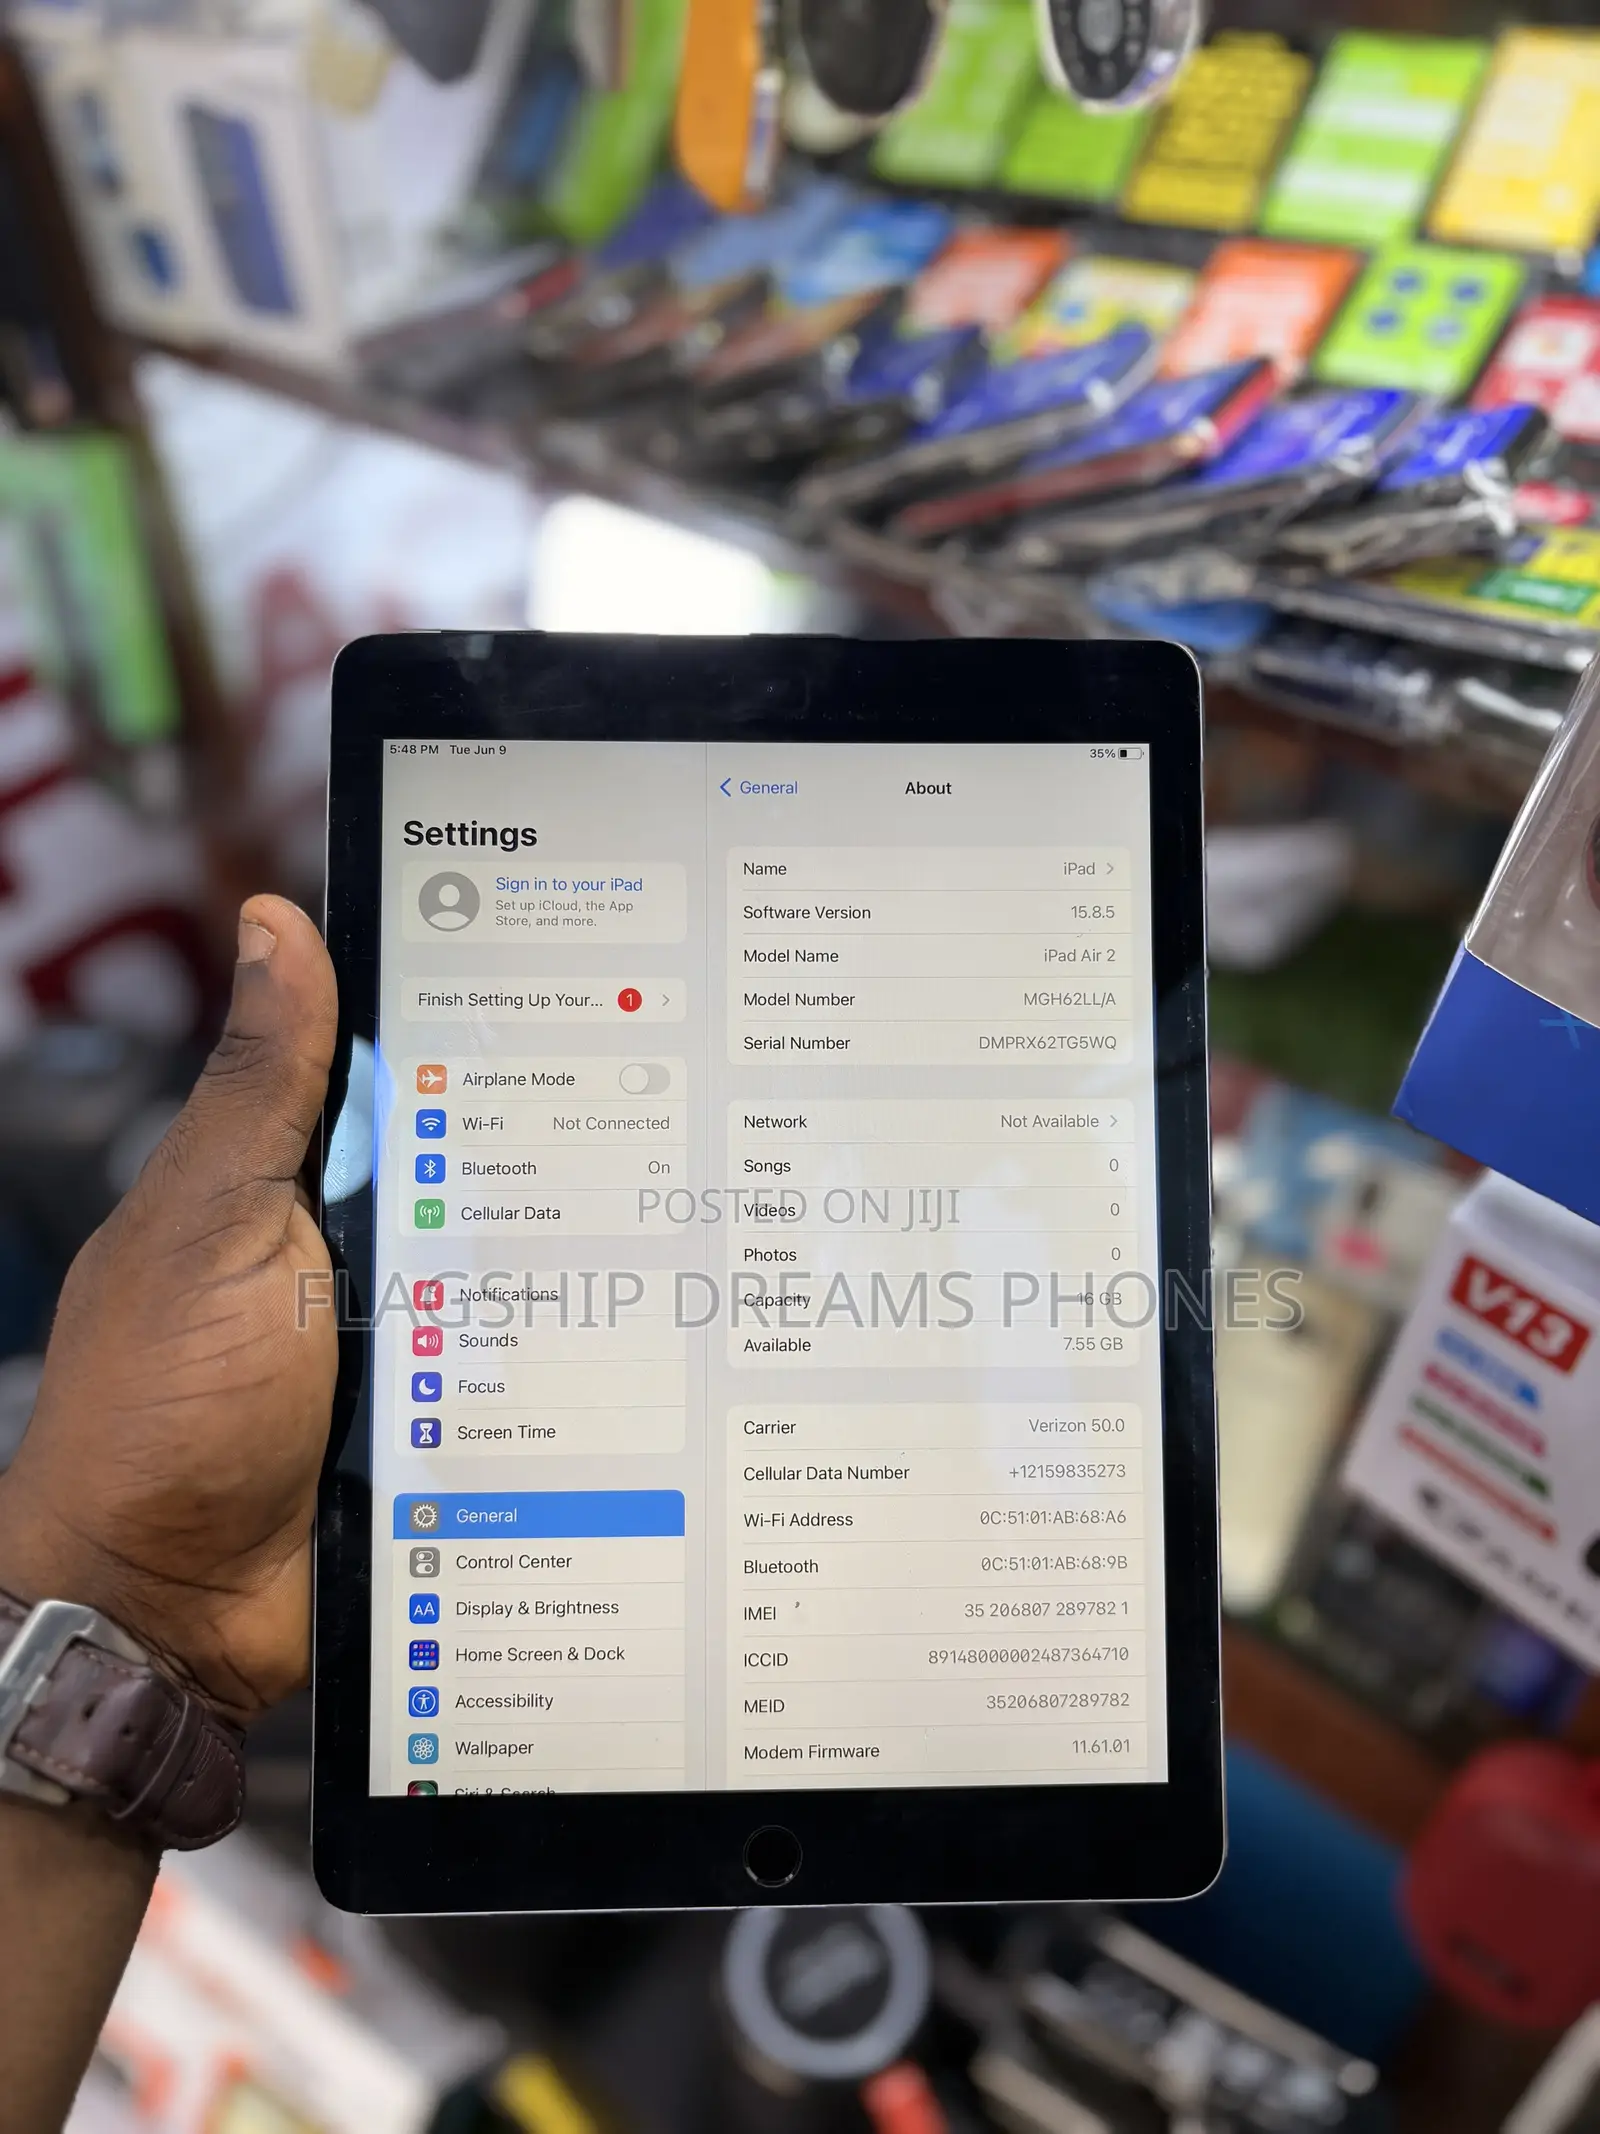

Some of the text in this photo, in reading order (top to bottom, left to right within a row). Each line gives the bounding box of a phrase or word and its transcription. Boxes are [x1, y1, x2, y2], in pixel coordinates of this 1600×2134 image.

[390, 745, 438, 754] 5:48 PM
[450, 745, 506, 755] Tue Jun 9
[1090, 749, 1116, 758] 35%
[740, 781, 797, 794] General
[905, 782, 951, 794] About
[404, 821, 537, 852] Settings
[744, 863, 786, 875] Name
[1064, 862, 1095, 875] iPad
[496, 877, 642, 893] Sign in to your iPad
[496, 900, 633, 913] Set up iCloud, the App
[744, 906, 870, 919] Software Version
[1072, 906, 1114, 918] 15.8.5
[496, 916, 596, 928] Store, and more.
[744, 949, 838, 962] Model Name
[1045, 949, 1115, 962] iPad Air 2
[419, 993, 602, 1009] Finish Setting Up Your...
[627, 994, 633, 1006] 1
[745, 993, 855, 1006] Model Number
[1025, 993, 1116, 1008] MGH62LL/A
[744, 1036, 850, 1049] Serial Number
[980, 1036, 1116, 1050] DMPRX62TG5WQ
[463, 1072, 575, 1088] Airplane Mode
[463, 1117, 503, 1130] Wi-Fi
[554, 1116, 669, 1130] Not Connected
[745, 1115, 807, 1128] Network
[1002, 1115, 1099, 1127] Not Available
[463, 1161, 536, 1175] Bluetooth
[649, 1161, 670, 1174] On
[744, 1159, 791, 1175] Songs
[1110, 1159, 1118, 1171] 0
[462, 1207, 560, 1220] Cellular Data
[744, 1204, 795, 1217] Videos
[1111, 1203, 1119, 1216] 0
[745, 1248, 796, 1261] Photos
[1112, 1247, 1120, 1260] 0
[460, 1288, 559, 1302] Notifications
[744, 1293, 810, 1309] Capacity
[1099, 1292, 1122, 1306] GB
[460, 1333, 518, 1347] Sounds
[744, 1338, 811, 1352] Available
[1064, 1337, 1123, 1350] 7.55 GB
[459, 1380, 505, 1393] Focus
[458, 1425, 556, 1439] Screen Time
[744, 1420, 796, 1434] Carrier
[1029, 1419, 1124, 1432] Verizon 50.0
[744, 1466, 909, 1481] Cellular Data Number
[1010, 1464, 1125, 1478] +12159835273
[456, 1508, 517, 1524] General
[744, 1513, 853, 1527] Wi-Fi Address
[980, 1510, 1126, 1524] 0C:51:01:AB:68:A6
[457, 1555, 572, 1569] Control Center
[745, 1559, 818, 1573] Bluetooth
[982, 1556, 1127, 1571] 0C:51:01:AB:68:9B
[457, 1601, 619, 1618] Display & Brightness
[745, 1607, 775, 1620] IMEI
[965, 1601, 1127, 1617] 35 206807 289782 1
[456, 1646, 624, 1661] Home Screen & Dock
[745, 1653, 788, 1667] ICCID
[929, 1647, 1128, 1664] 89148000002487364710
[455, 1694, 553, 1710] Accessibility
[745, 1700, 784, 1713] MEID
[987, 1693, 1129, 1709] 35206807289782
[456, 1741, 534, 1757] Wallpaper
[745, 1744, 879, 1759] Modem Firmware
[1073, 1739, 1129, 1753] 11.61.01
